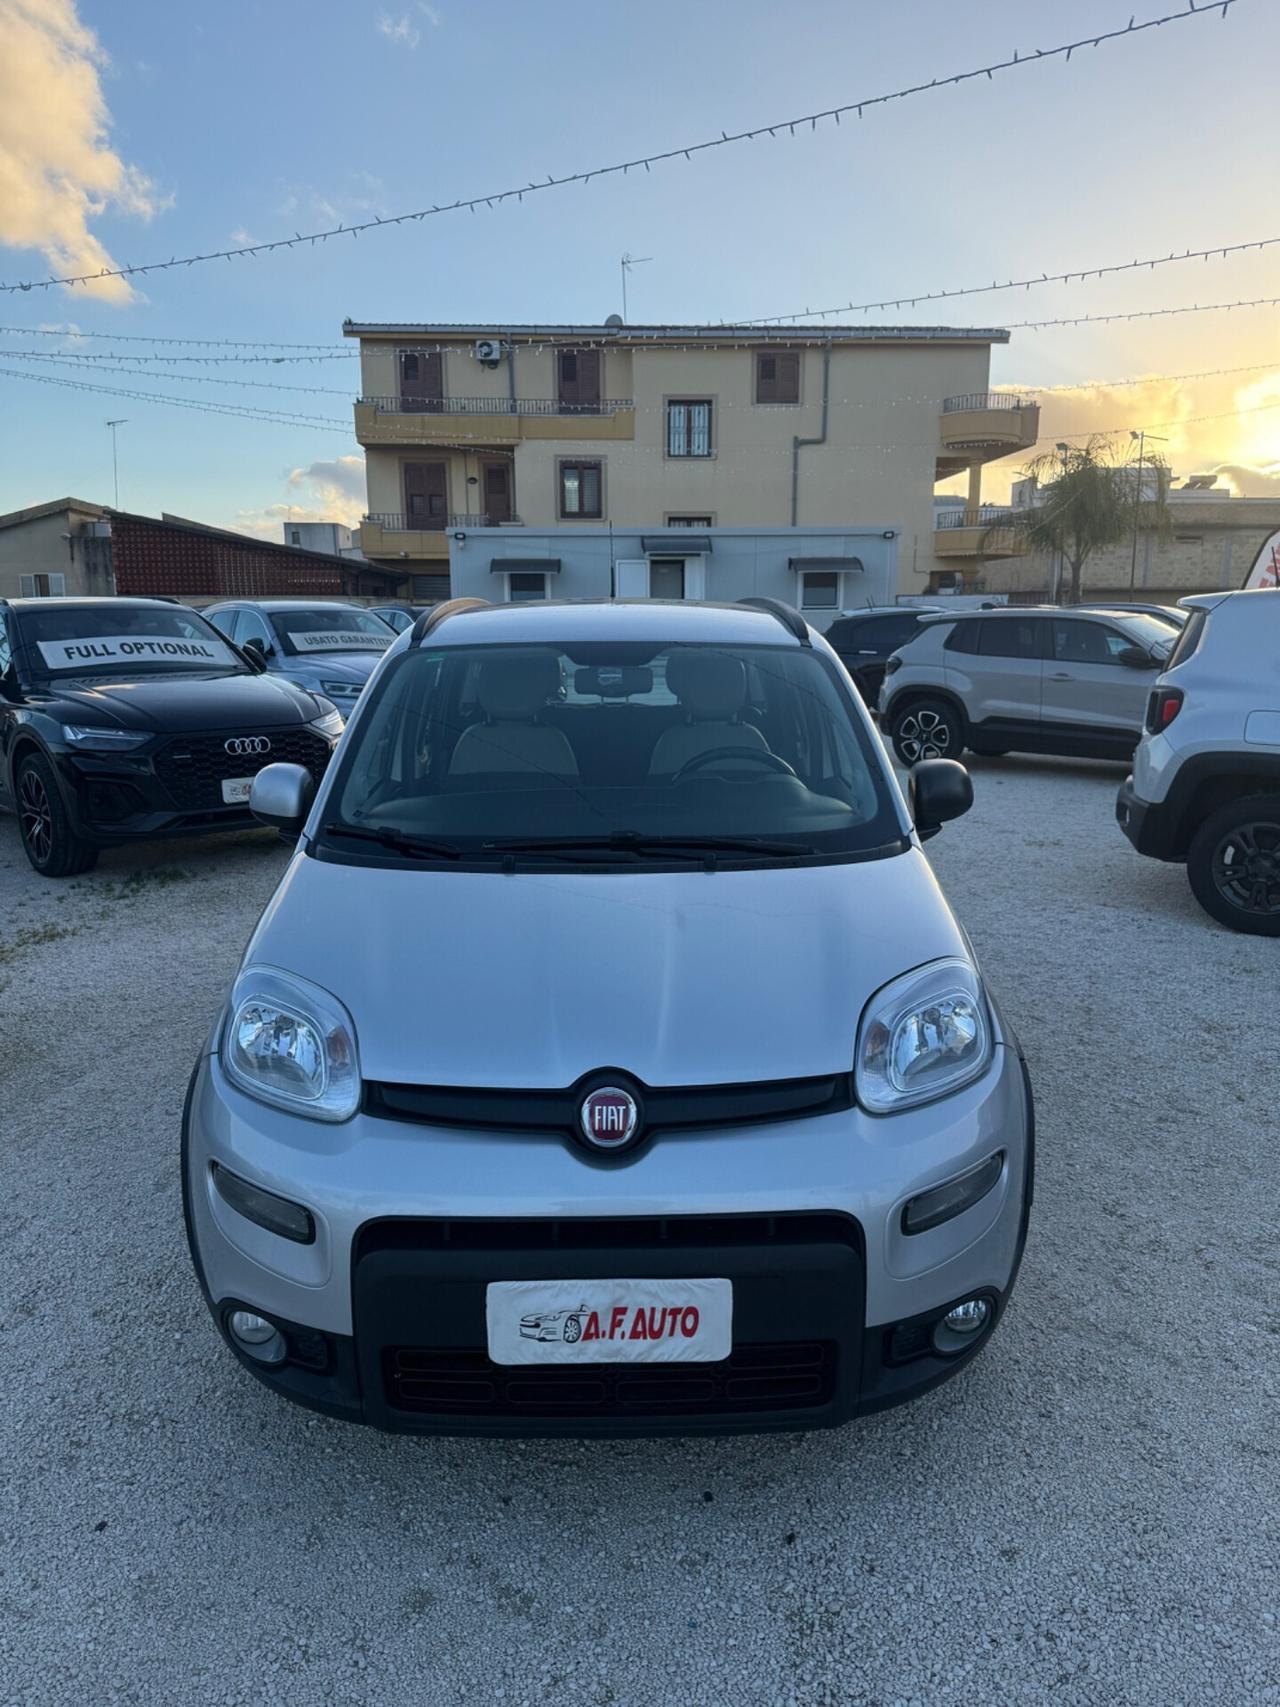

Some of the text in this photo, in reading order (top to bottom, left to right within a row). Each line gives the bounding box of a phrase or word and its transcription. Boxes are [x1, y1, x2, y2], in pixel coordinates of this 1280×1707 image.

[304, 635, 339, 646] USATO
[64, 642, 215, 660] FULL OPTIONAL
[594, 1105, 626, 1131] FIAT
